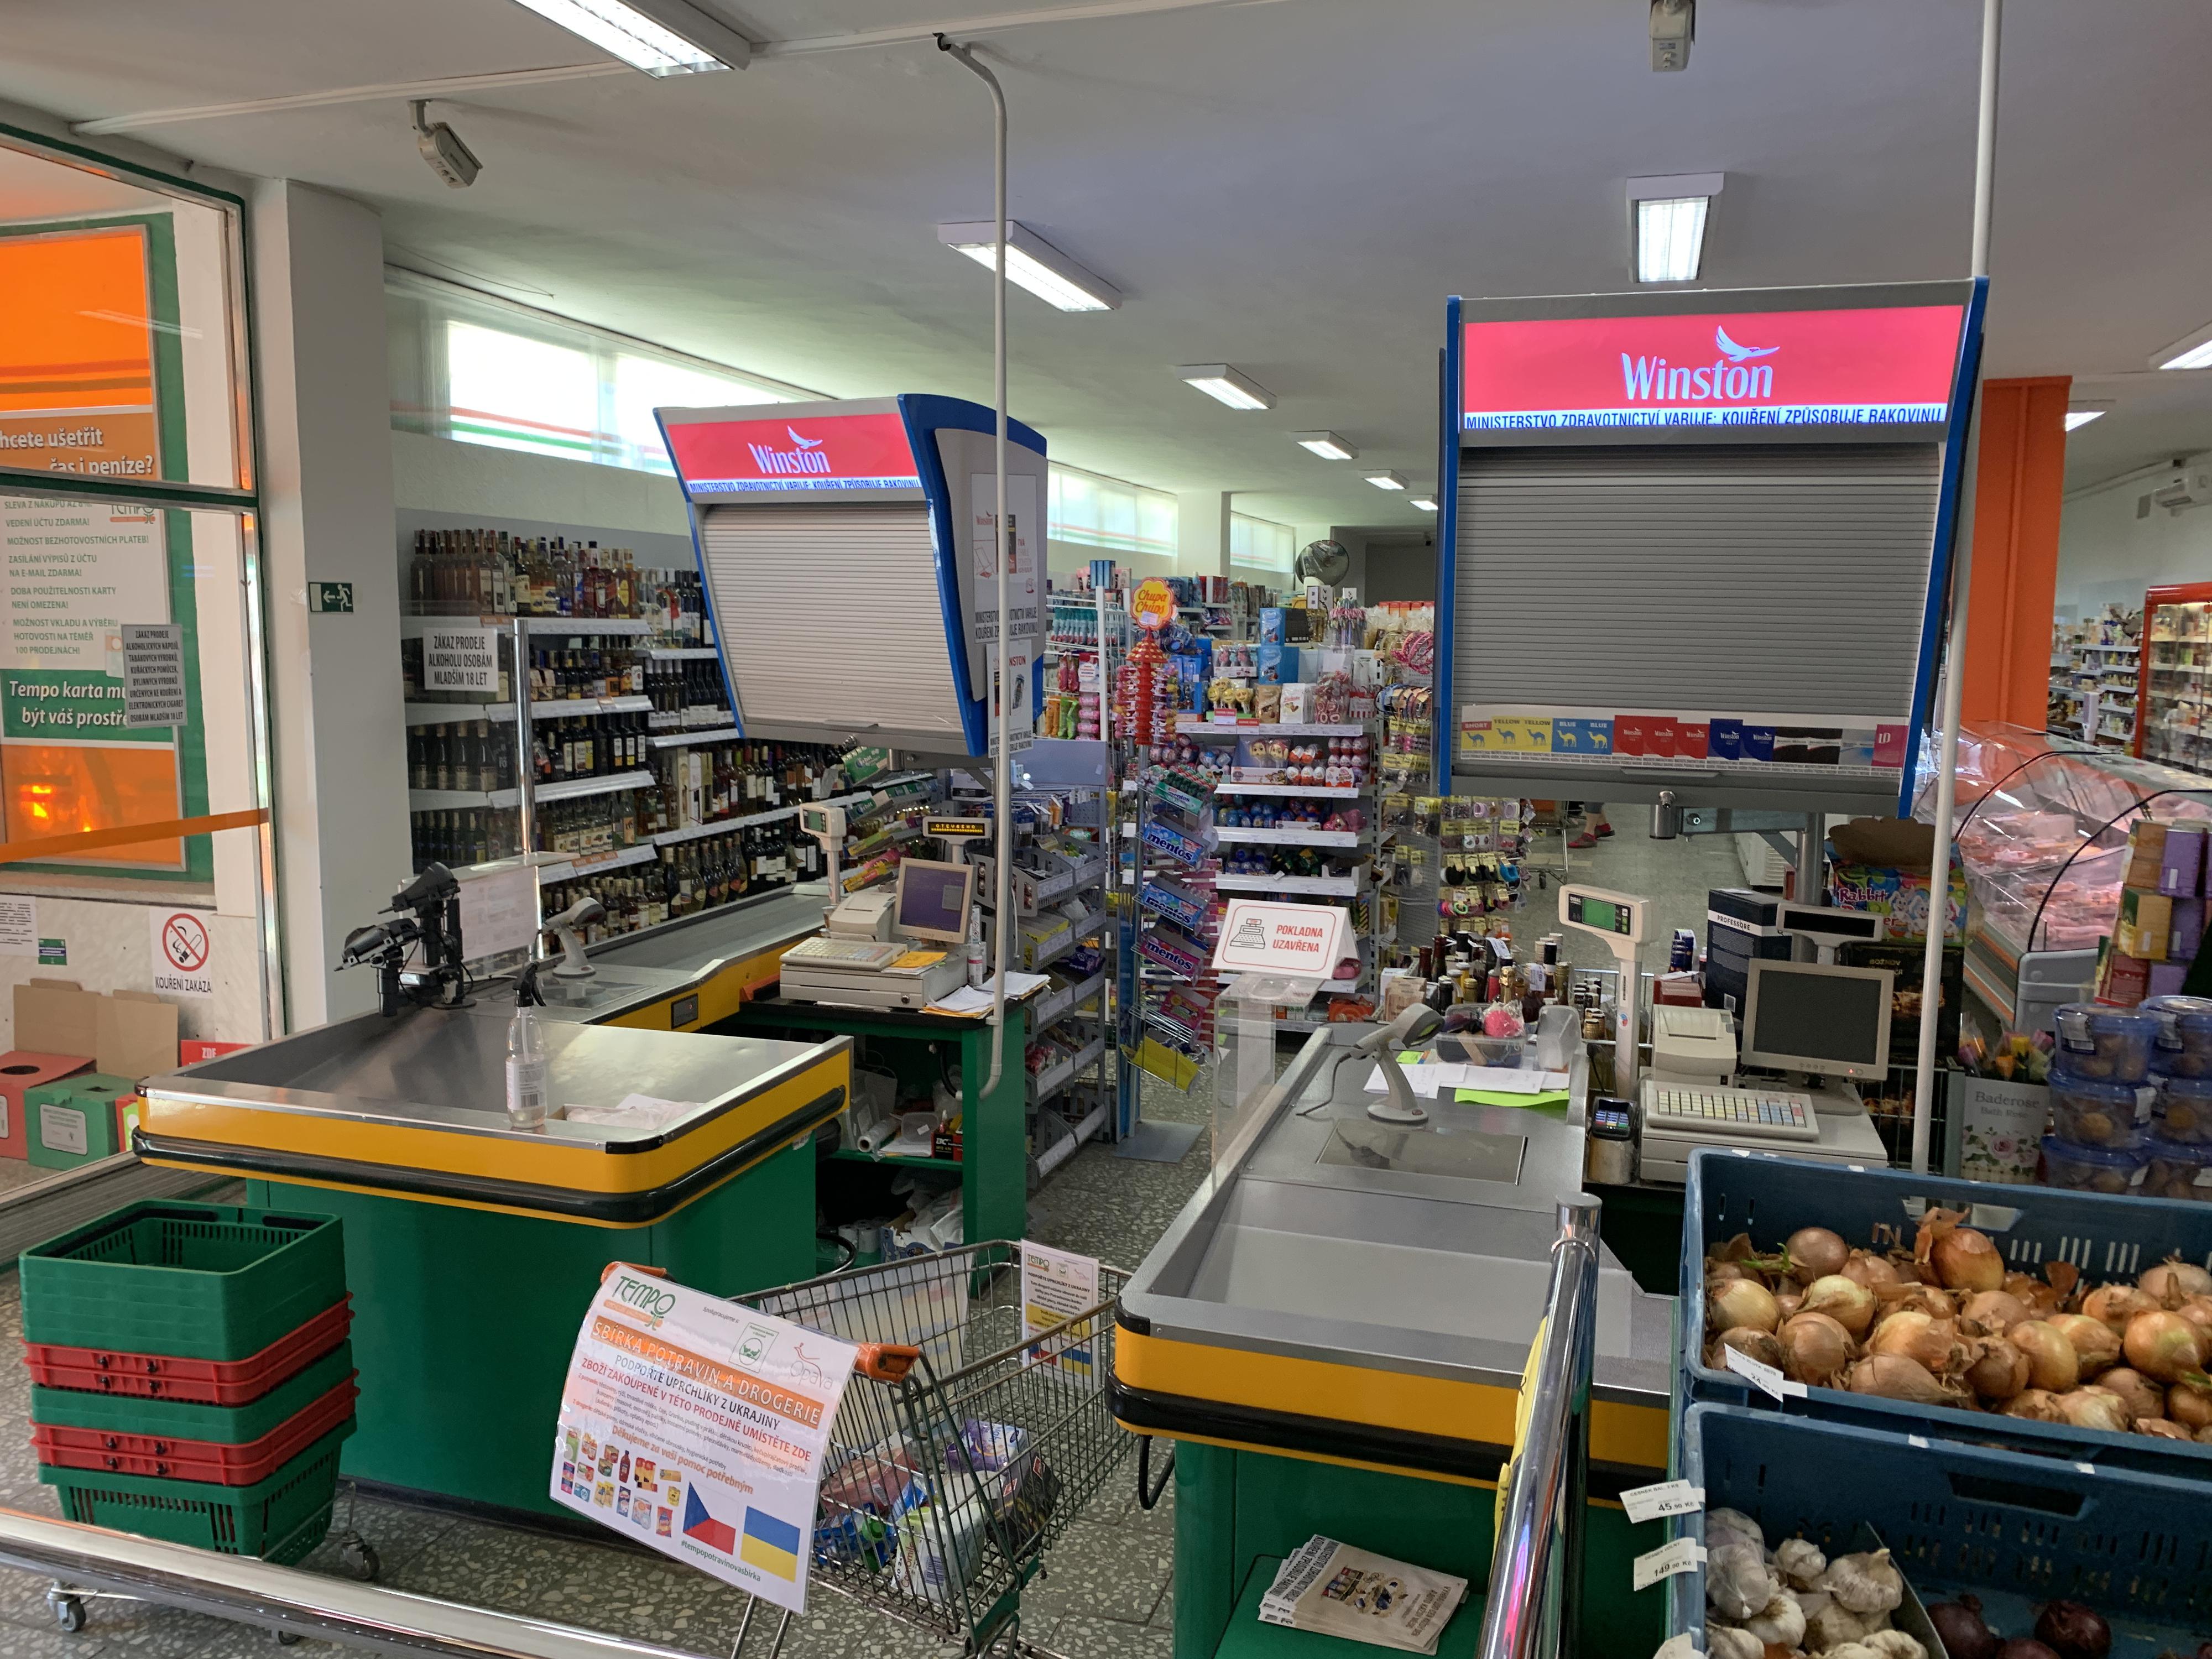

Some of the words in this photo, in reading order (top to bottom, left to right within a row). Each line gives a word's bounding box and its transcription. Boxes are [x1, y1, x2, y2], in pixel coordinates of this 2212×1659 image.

[1621, 352, 1773, 400] Winston
[1466, 414, 1557, 429] MINISTERSTVO
[1562, 409, 1661, 427] ZDRAVOTNICTVÍ
[1722, 407, 1782, 425] KOUŘENÍ
[1786, 406, 1864, 424] ZPŮSOBUJE
[1869, 408, 1942, 423] RAKOVINU
[0, 430, 44, 448] hcete
[48, 426, 103, 447] ušetřit
[50, 457, 76, 472] čas
[79, 457, 84, 473] i
[88, 455, 154, 474] peníze?
[748, 442, 831, 474] Winston
[690, 482, 735, 493] MINISTERSTVO
[736, 478, 783, 492] ZDRAVOTNICTVÍ
[812, 479, 842, 490] KOUŘENÍ
[5, 500, 27, 509] SLEVA
[28, 500, 33, 508] Z
[6, 518, 32, 527] VEDENÍ
[34, 518, 53, 526] ÚČTU
[56, 518, 89, 526] ZDARMA!
[7, 536, 43, 545] MOŽNOST
[45, 535, 117, 545] BEZHOTOVOSTNÍCH
[119, 535, 149, 544] PLATEB!
[9, 555, 40, 563] ZASÍLÁNÍ
[43, 554, 68, 562] VÝPISŮ
[77, 554, 97, 562] ÚČTU
[33, 586, 91, 595] POUŽITELNOSTI
[1138, 589, 1167, 603] Chupa
[12, 600, 29, 608] NENÍ
[1136, 601, 1164, 614] Chups
[13, 618, 49, 627] MOŽNOST
[69, 632, 93, 640] TÉMĚŘ
[434, 633, 455, 649] ZÁKAZ
[456, 636, 485, 650] PRODEJE
[29, 645, 80, 654] PRODEJNÁCH!
[429, 653, 462, 667] ALKOHOLU
[463, 651, 493, 667] OSOBÁM
[434, 669, 465, 685] MLADŠÍM
[466, 672, 474, 685] 18
[476, 672, 487, 686] LET
[9, 681, 59, 701] Tempo
[63, 681, 103, 698] karta
[107, 686, 126, 699] mu
[22, 707, 45, 728] být
[49, 708, 73, 724] váš
[76, 709, 128, 729] prostře
[1879, 732, 1891, 744] LD
[1147, 833, 1193, 861] mentos
[1839, 887, 1886, 902] Rabbit
[1146, 896, 1191, 924] mentos
[1276, 924, 1323, 938] POKLADNA
[1717, 915, 1751, 931] PROFESSORE
[1272, 939, 1319, 953] UZAVŘENA
[1147, 942, 1192, 970] mentos
[155, 974, 184, 990] KOUŘENÍ
[185, 977, 212, 993] ZAKÁZÁ
[1975, 1091, 2040, 1109] Baderose
[1027, 1254, 1050, 1267] TEMPO
[612, 1276, 676, 1315] TEMPO
[1071, 1285, 1090, 1293] UKRAJINY
[703, 1306, 736, 1323] Spolupracujeme
[592, 1322, 642, 1353] SBÍRKA
[646, 1342, 721, 1385] POTRAVIN
[723, 1375, 733, 1391] A
[738, 1380, 821, 1426] DROGERIE
[790, 1360, 833, 1390] Opava
[615, 1355, 665, 1383] PODPOŘTE
[666, 1375, 719, 1406] UPRCHLÍKY
[721, 1398, 728, 1410] Z
[729, 1401, 780, 1431] UKRAJINY
[582, 1358, 608, 1376] ZBOŽÍ
[607, 1368, 659, 1398] ZAKOUPENÉ
[661, 1390, 667, 1401] V
[669, 1391, 691, 1411] TÉTO
[693, 1404, 741, 1433] PRODEJNĚ
[743, 1424, 791, 1453] UMÍSTĚTE
[791, 1444, 812, 1462] ZDE
[612, 1425, 650, 1449] Děkujeme
[650, 1443, 660, 1453] za
[661, 1448, 677, 1462] vaši
[677, 1455, 706, 1474] pomoc
[706, 1467, 754, 1494] potřebným
[681, 1540, 761, 1582] #tempopotravinovasbirka
